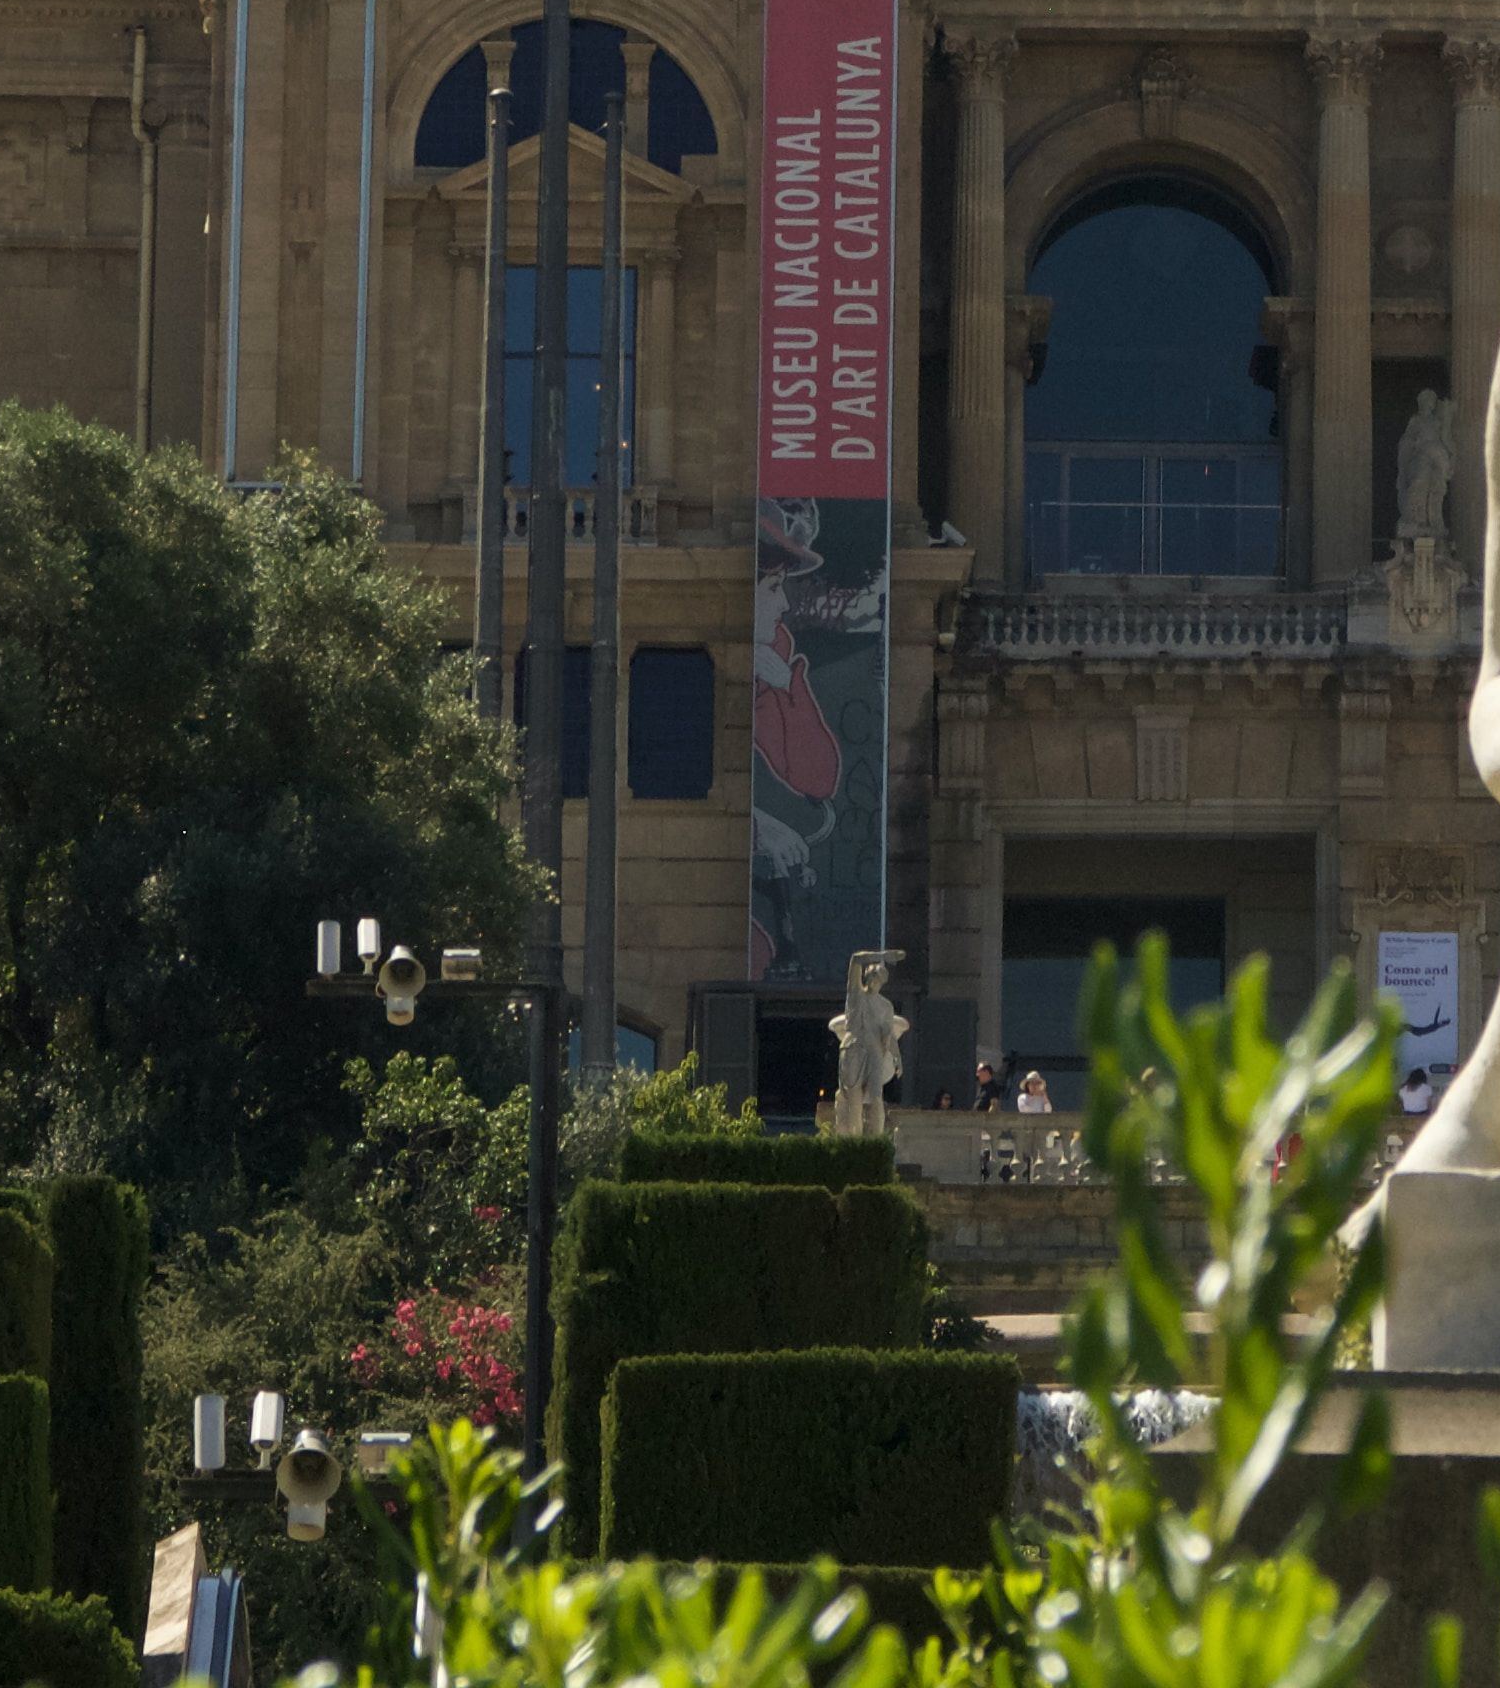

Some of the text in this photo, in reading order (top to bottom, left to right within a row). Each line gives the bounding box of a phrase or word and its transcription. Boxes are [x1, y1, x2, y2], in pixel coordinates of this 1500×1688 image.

[771, 108, 821, 459] MUSEU NACIONAL
[830, 36, 882, 460] D'ART DE CATALUNYA
[1384, 964, 1448, 975] Come and
[1384, 975, 1436, 987] bounce!
